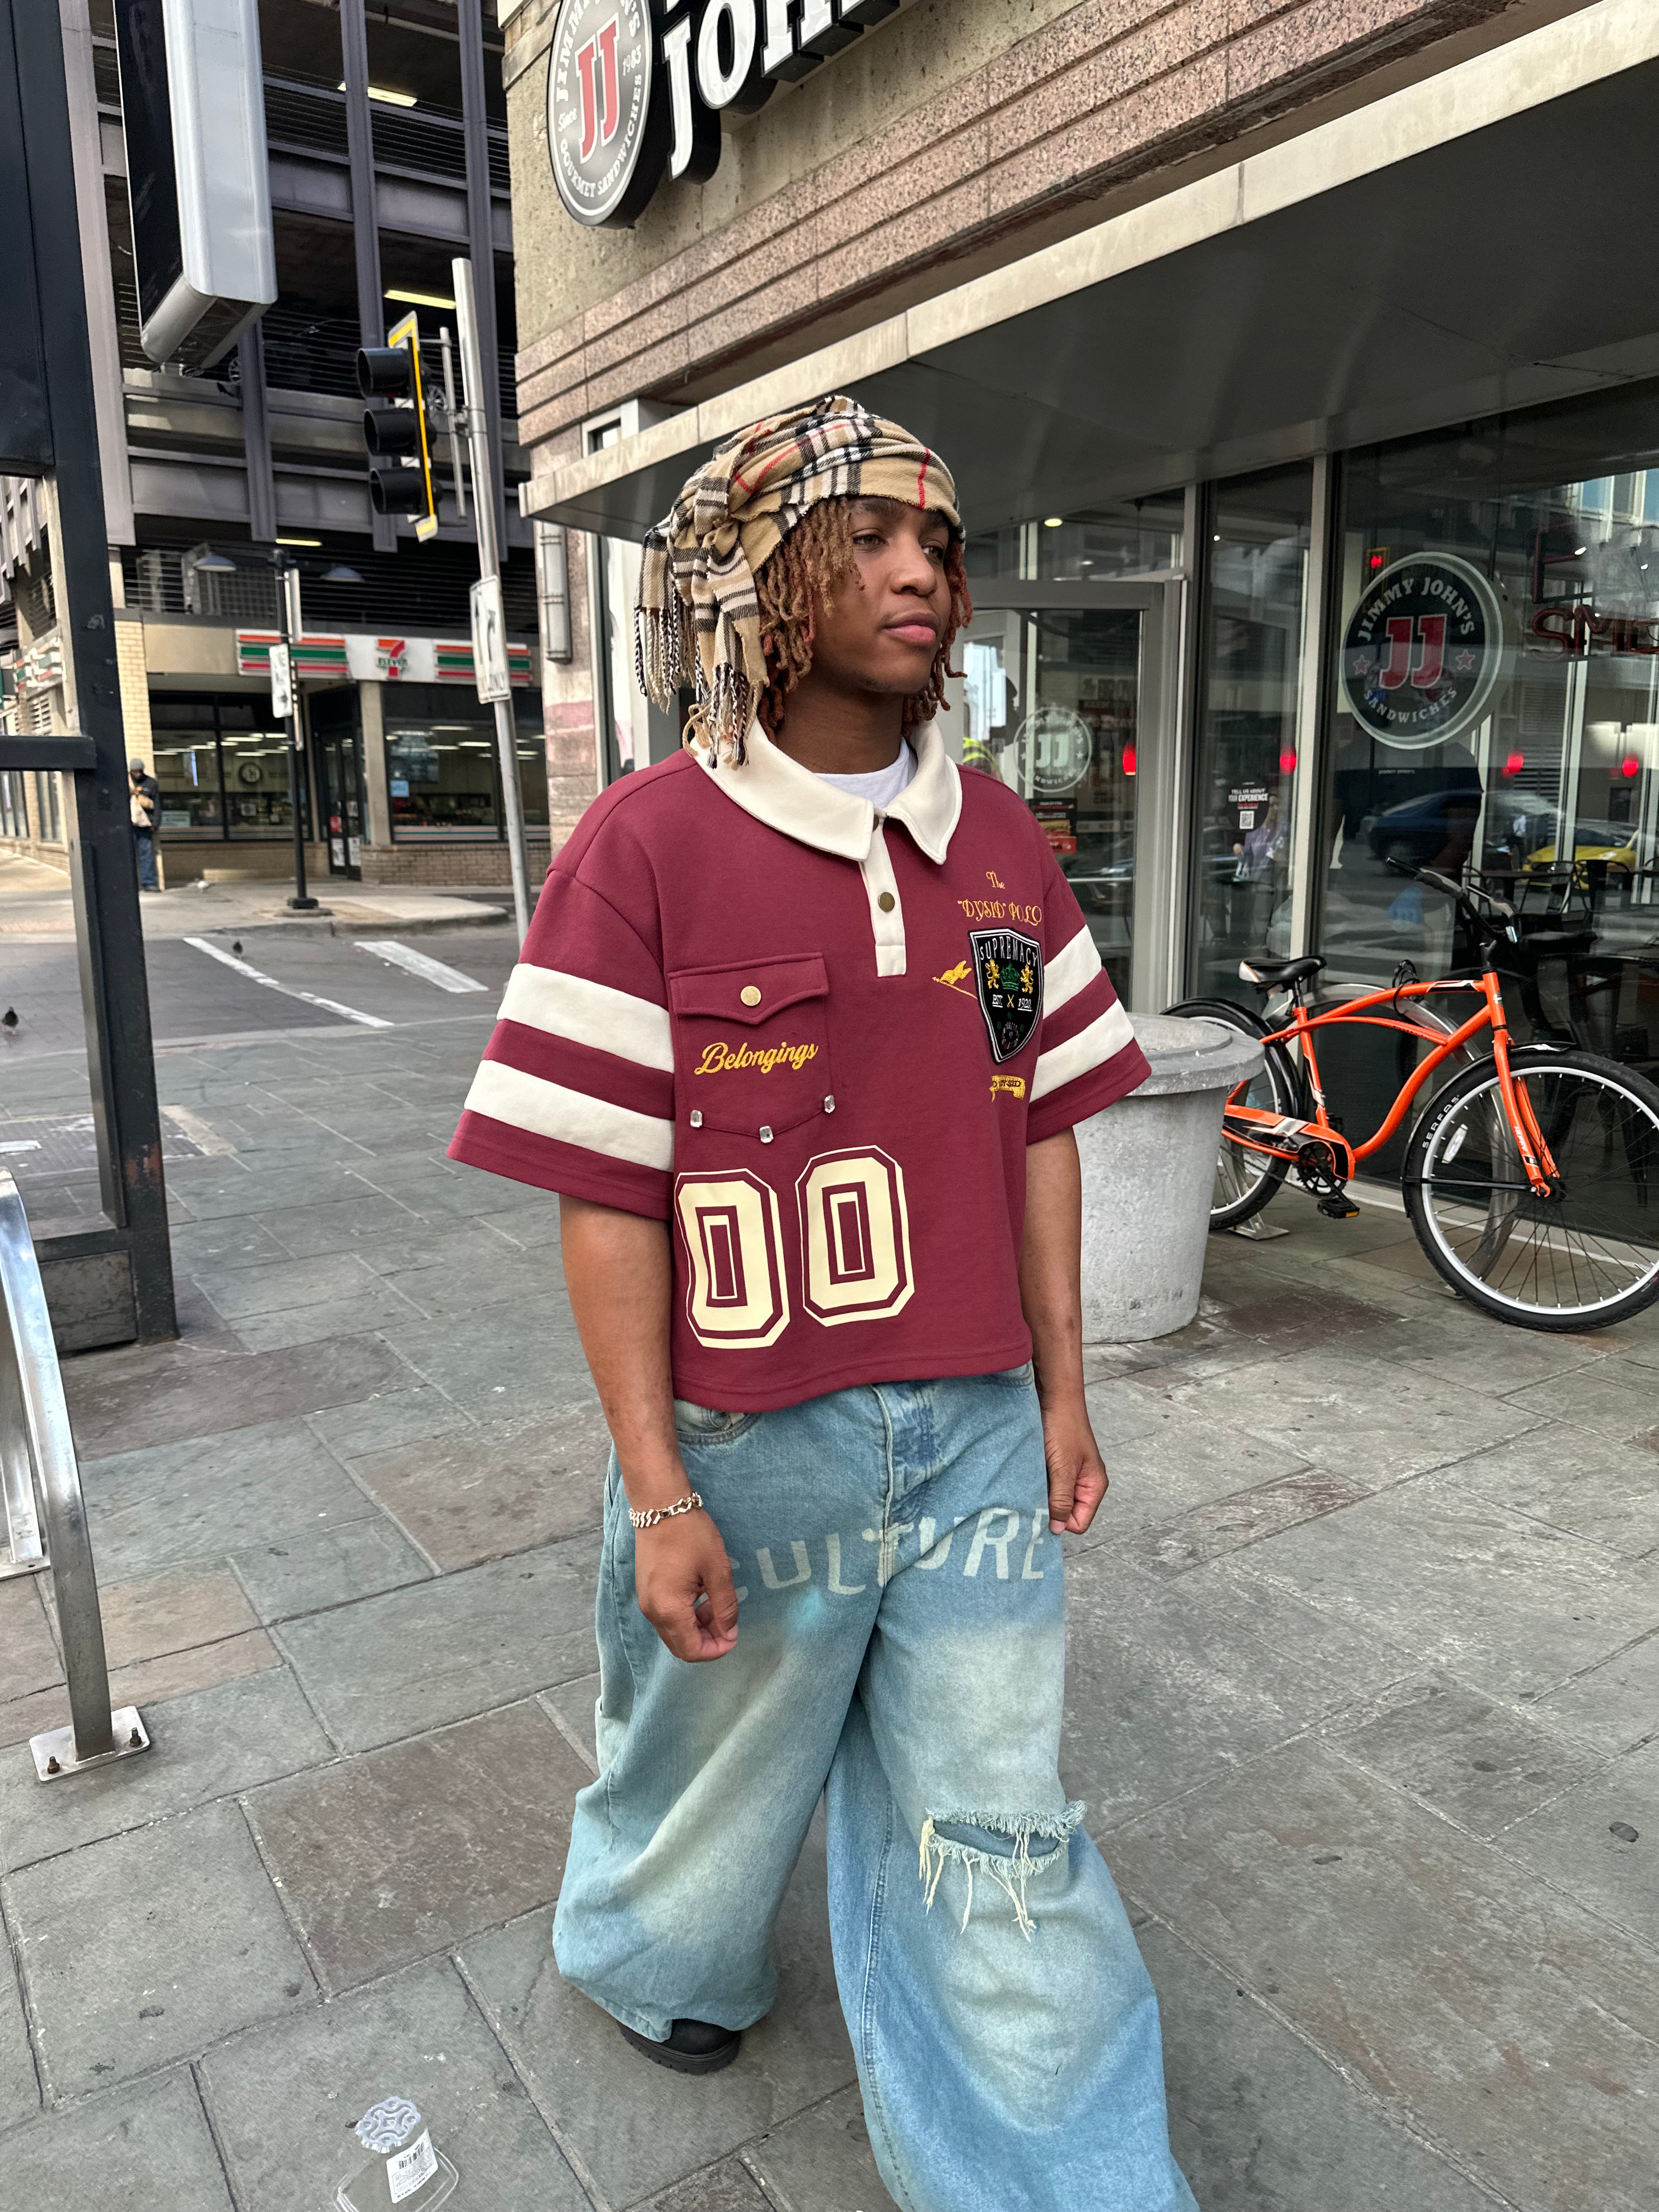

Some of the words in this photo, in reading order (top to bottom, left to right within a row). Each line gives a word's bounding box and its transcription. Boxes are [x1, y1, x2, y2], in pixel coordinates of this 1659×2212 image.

[556, 0, 590, 102] JIMM
[560, 138, 596, 198] GOURMET
[597, 74, 642, 196] SANDWICHES
[1357, 578, 1414, 642] JIMMY
[1421, 577, 1475, 636] JOHN'S
[1379, 613, 1448, 690] JJ
[1364, 687, 1457, 724] SANDWICHES
[1238, 793, 1268, 802] EXPERIENCE
[986, 871, 1006, 889] The
[1008, 902, 1042, 926] POLO
[980, 936, 1037, 967] SUPREMACY
[694, 1041, 819, 1075] Belongings
[1422, 1097, 1459, 1149] SERFAS
[727, 1506, 1051, 1604] ULTURE
